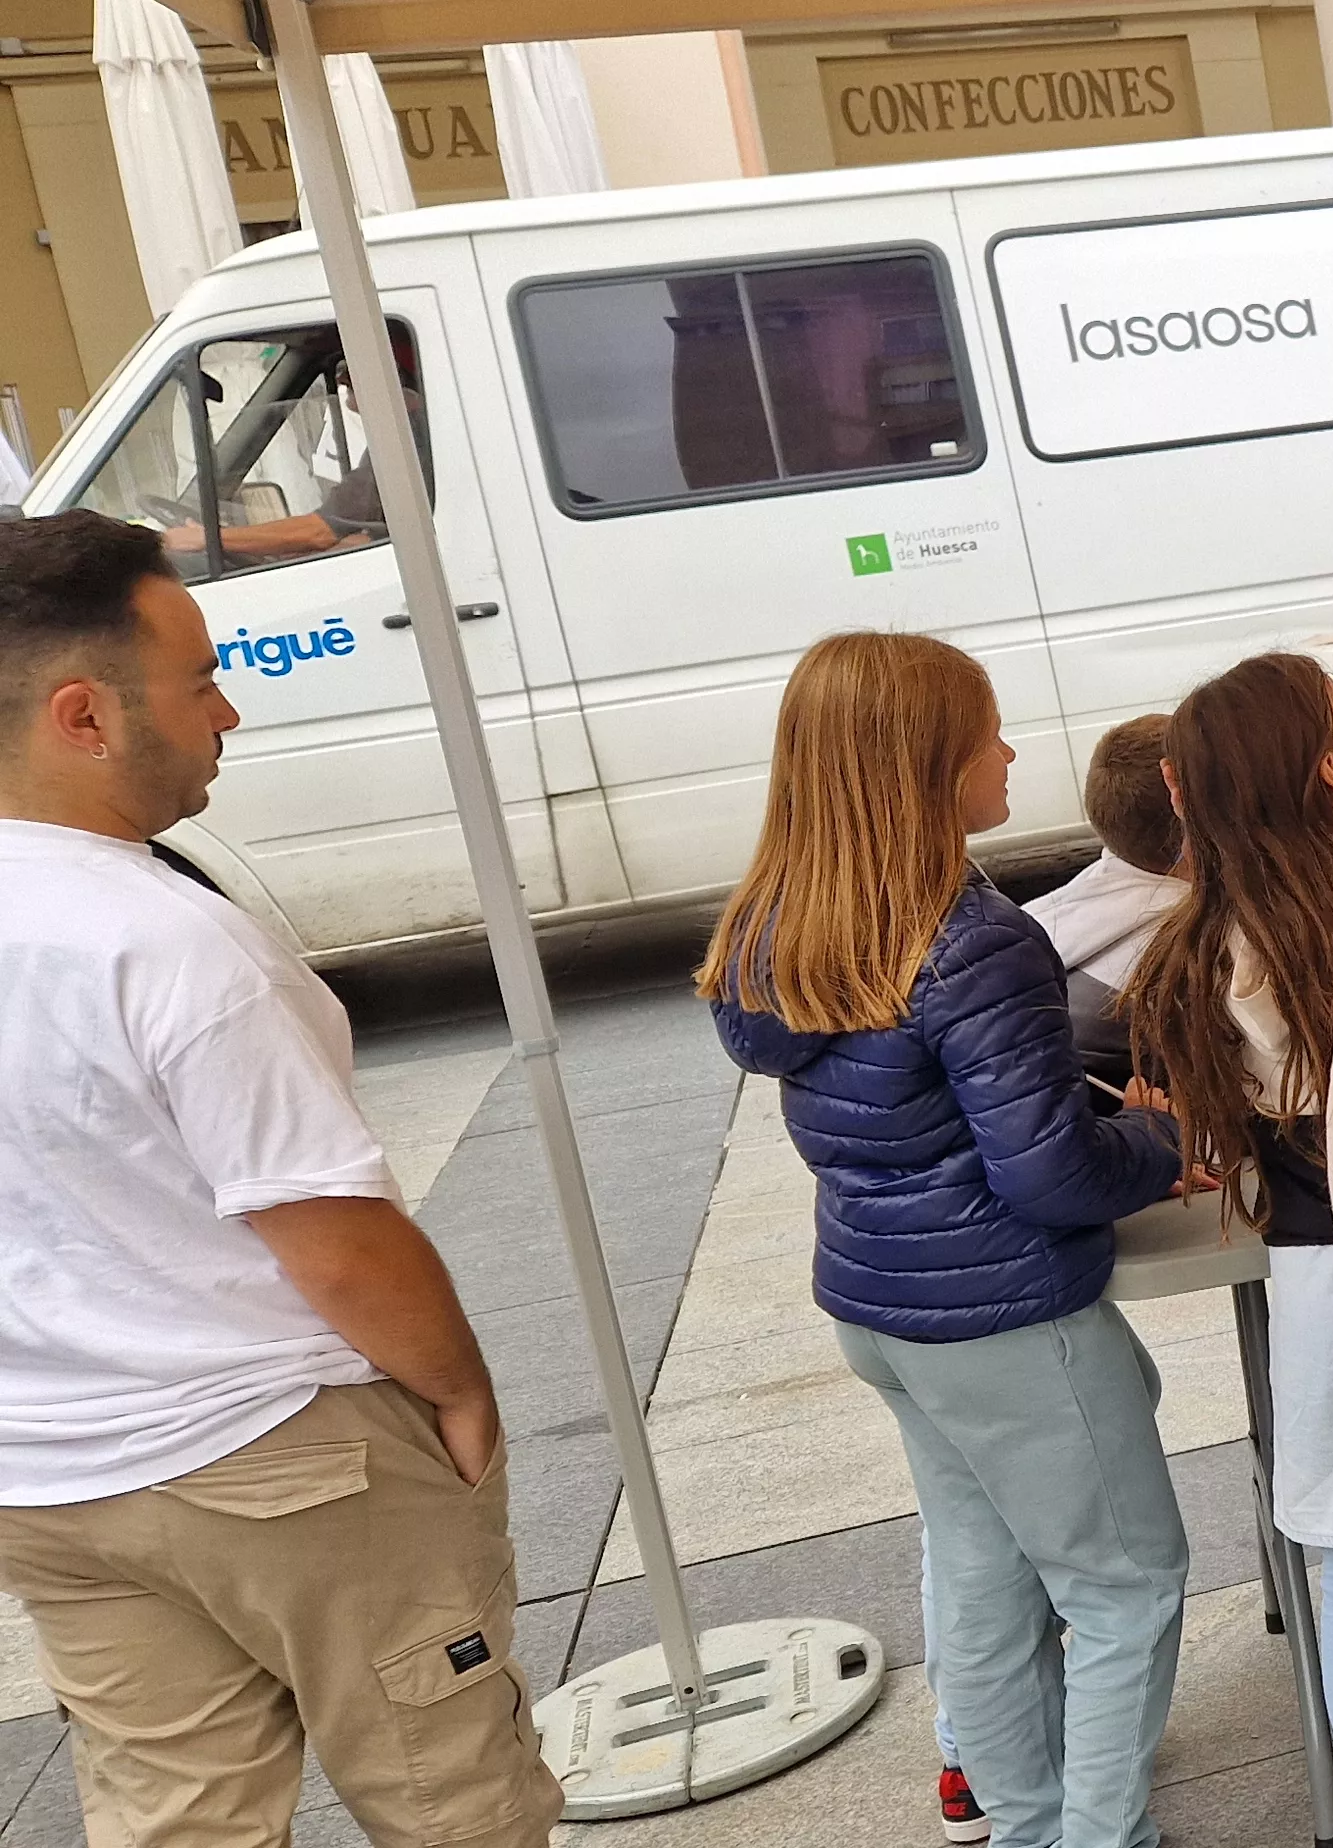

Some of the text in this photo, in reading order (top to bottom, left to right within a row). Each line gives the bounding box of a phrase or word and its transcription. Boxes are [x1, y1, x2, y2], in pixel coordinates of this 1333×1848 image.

[839, 64, 1176, 138] CONFECCIONES
[1060, 298, 1318, 363] lasaosa
[893, 519, 1001, 546] Ayuntamiento
[896, 540, 979, 561] de Huesca
[216, 617, 356, 678] riguē
